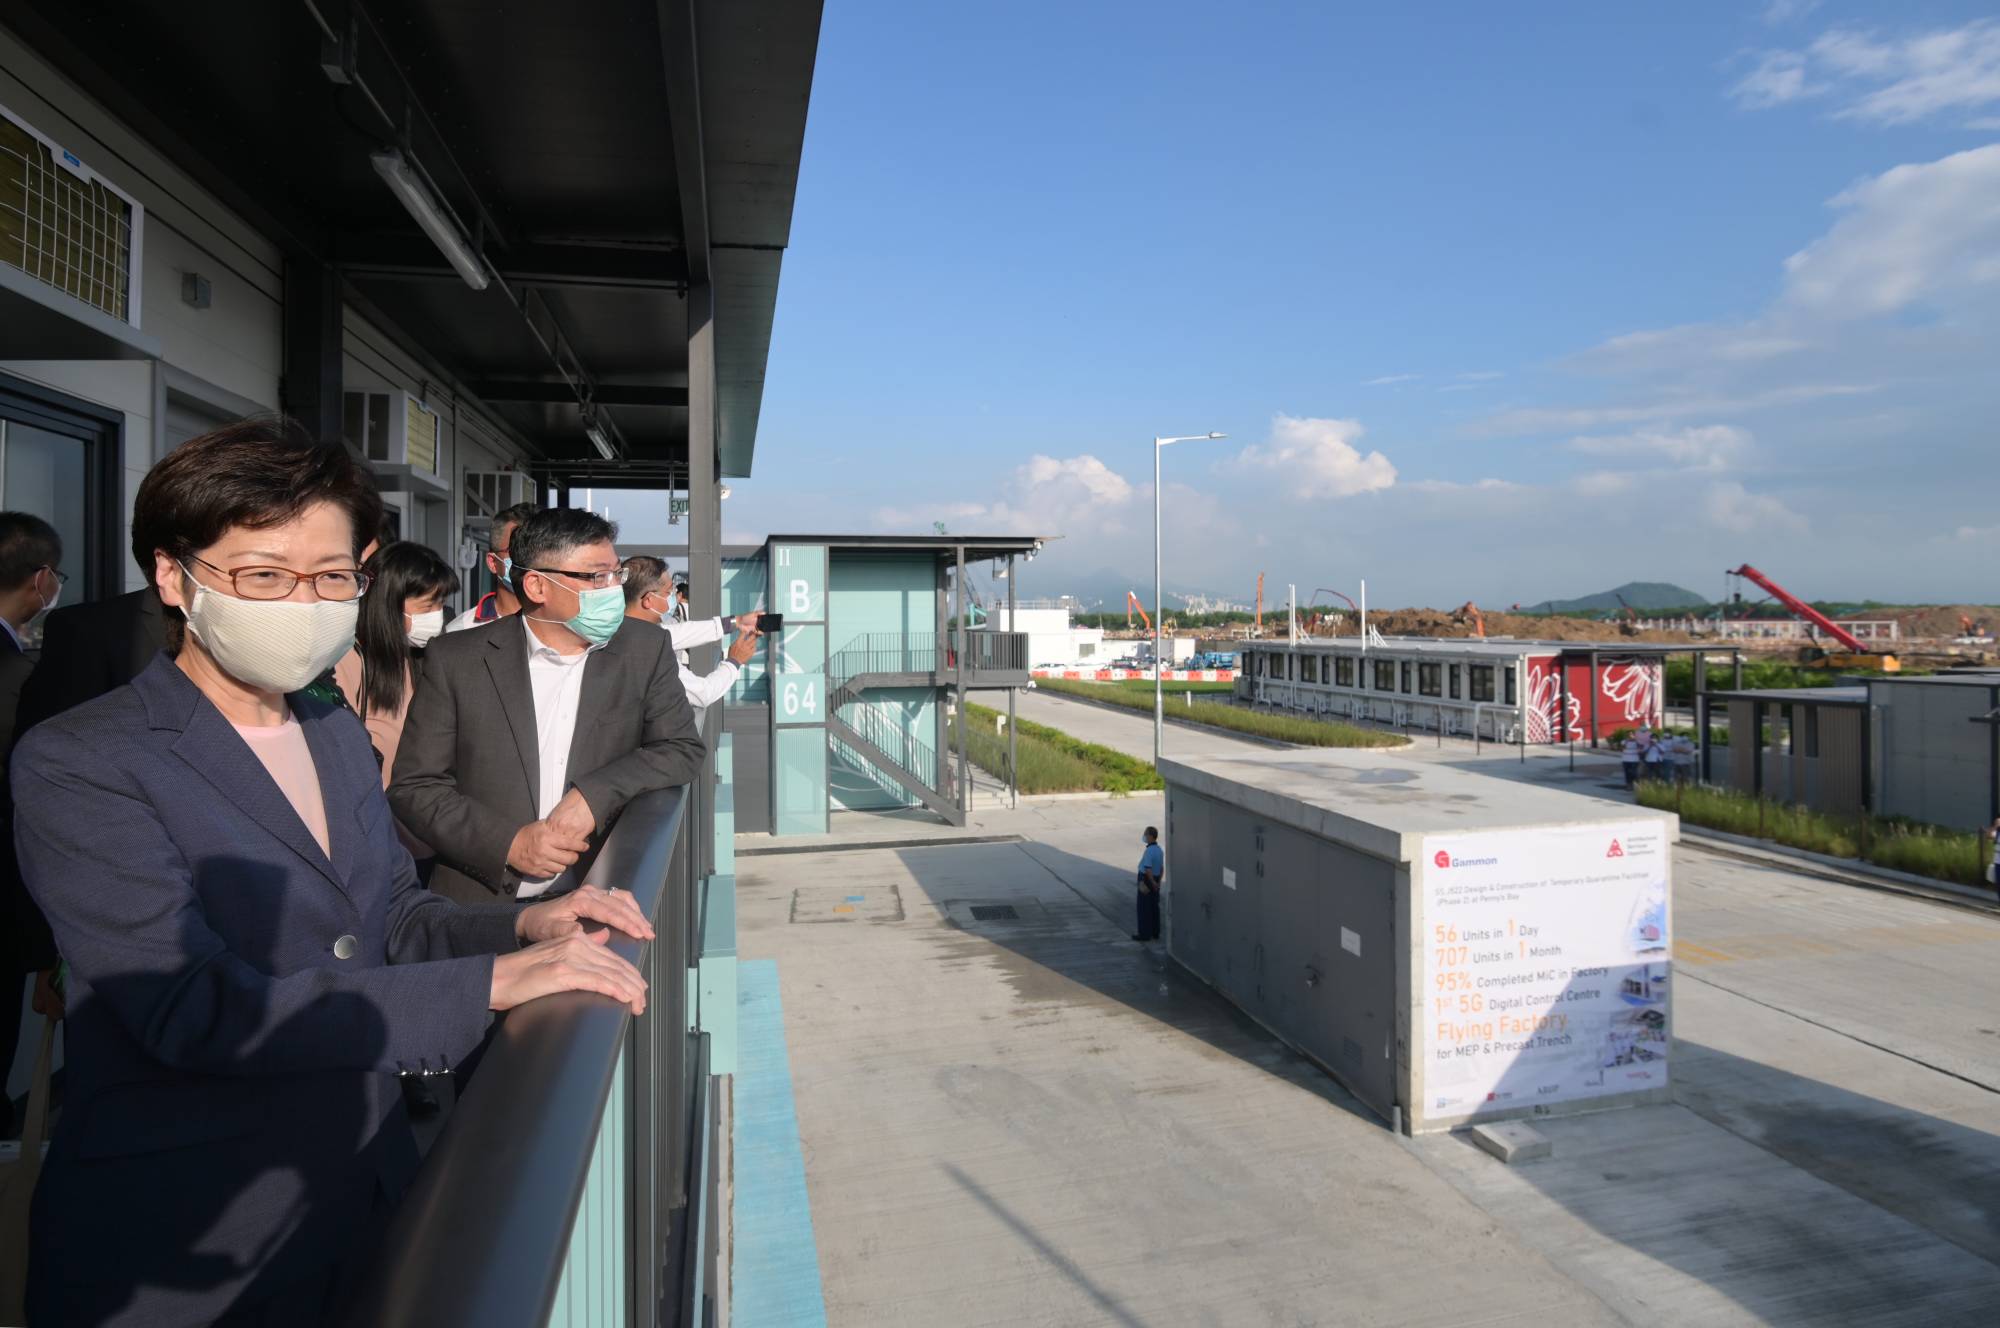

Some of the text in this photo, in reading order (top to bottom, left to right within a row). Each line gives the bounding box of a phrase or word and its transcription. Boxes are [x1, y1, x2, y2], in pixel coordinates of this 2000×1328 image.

[671, 500, 688, 512] EXIT
[789, 579, 811, 613] B
[783, 682, 817, 716] 64
[1452, 856, 1498, 868] Gammon
[1435, 919, 1539, 943] 56 Units in 1 Day
[1435, 940, 1562, 968] 707 Units in 1 Month
[1435, 971, 1473, 992] 95%
[1476, 972, 1534, 988] Completed
[1558, 968, 1568, 979] in
[1571, 966, 1609, 980] Factory
[1459, 993, 1483, 1014] 5G
[1489, 995, 1523, 1011] Digital
[1526, 992, 1564, 1007] Control
[1567, 988, 1601, 1002] Centre
[1437, 1011, 1569, 1044] Flying Factory
[1437, 1033, 1573, 1060] for MEP & Precast Trench
